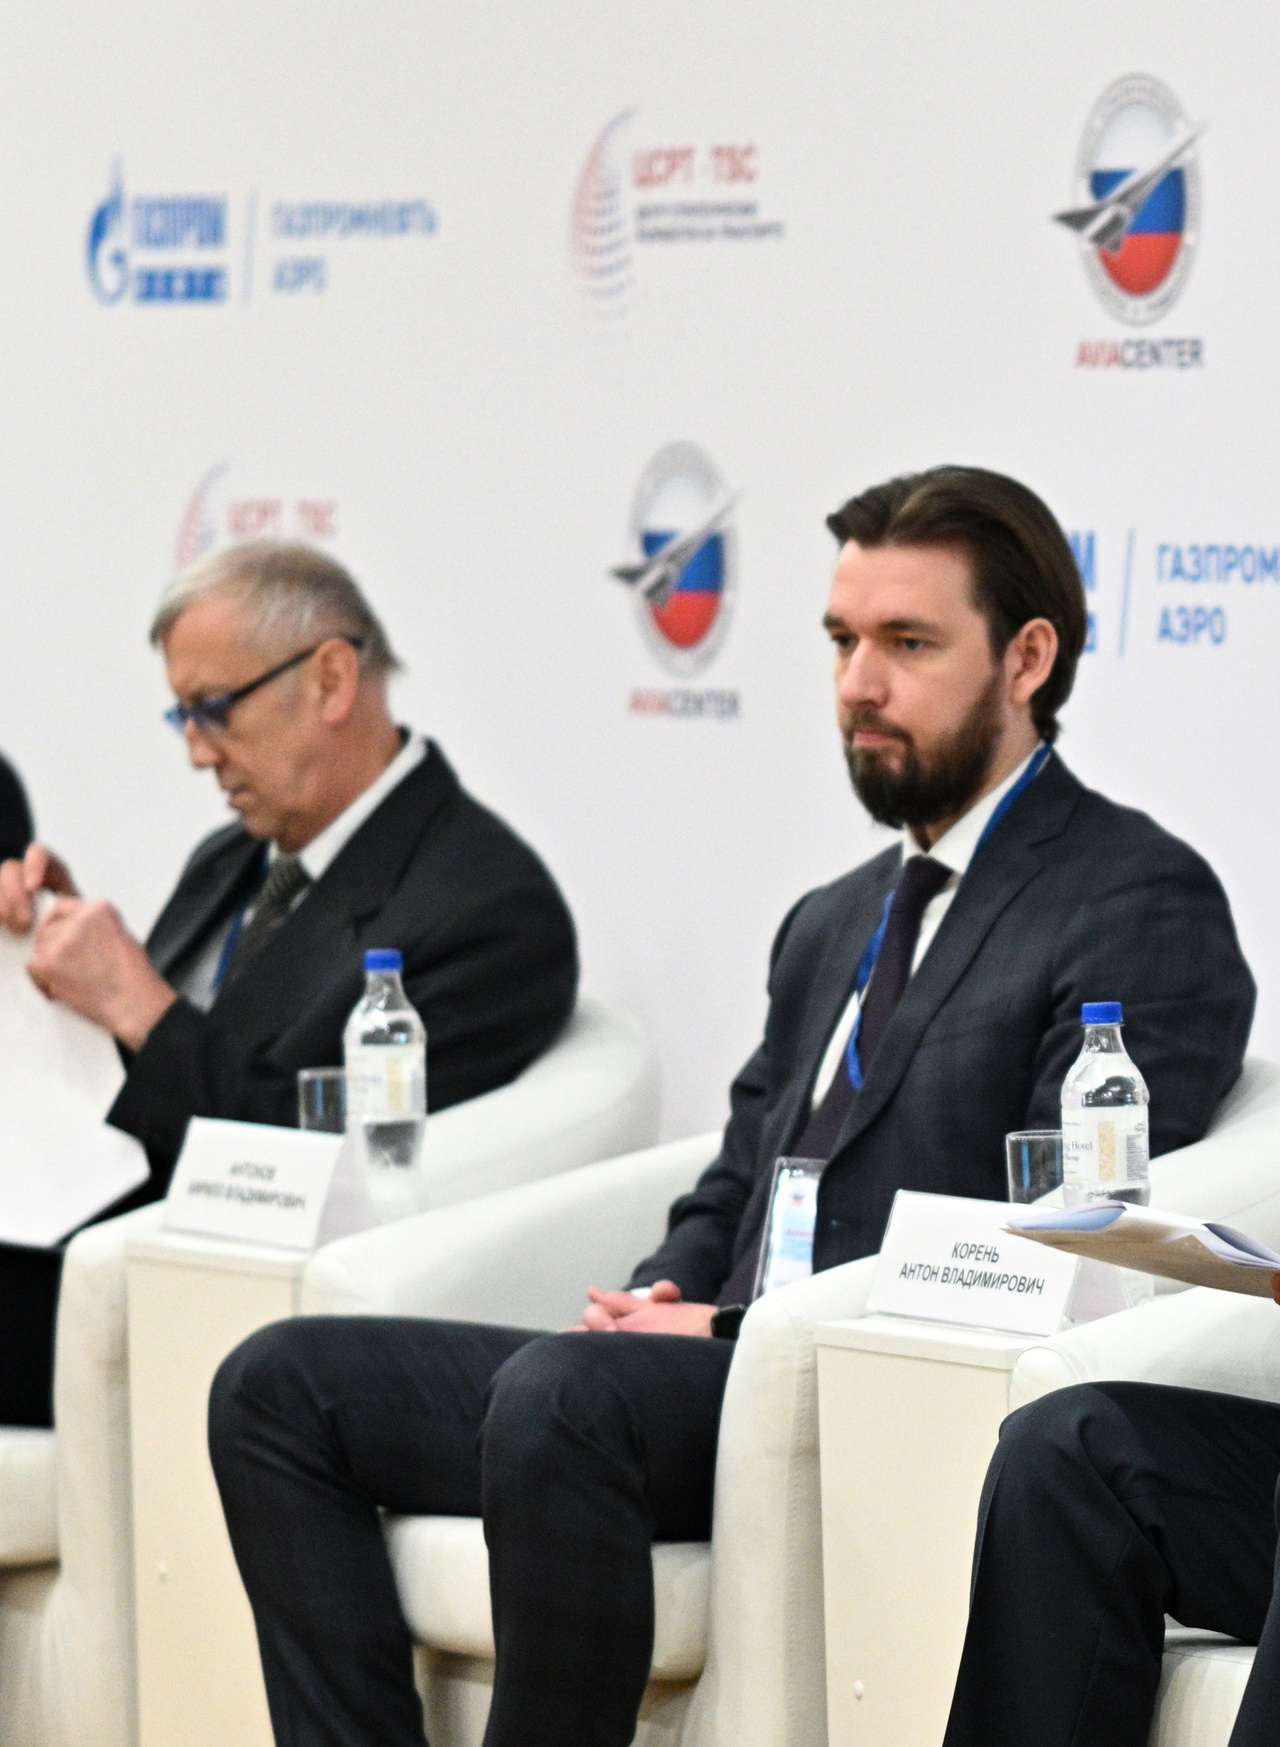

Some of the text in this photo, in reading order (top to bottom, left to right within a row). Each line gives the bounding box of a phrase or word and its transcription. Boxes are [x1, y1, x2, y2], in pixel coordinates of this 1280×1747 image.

[1075, 339, 1204, 368] AVIACENTER
[1157, 605, 1226, 645] АЭРО
[952, 1242, 1000, 1263] КОРЕНЬ
[899, 1262, 1045, 1295] АНТОН ВЛАДИМИРОВИЧ
